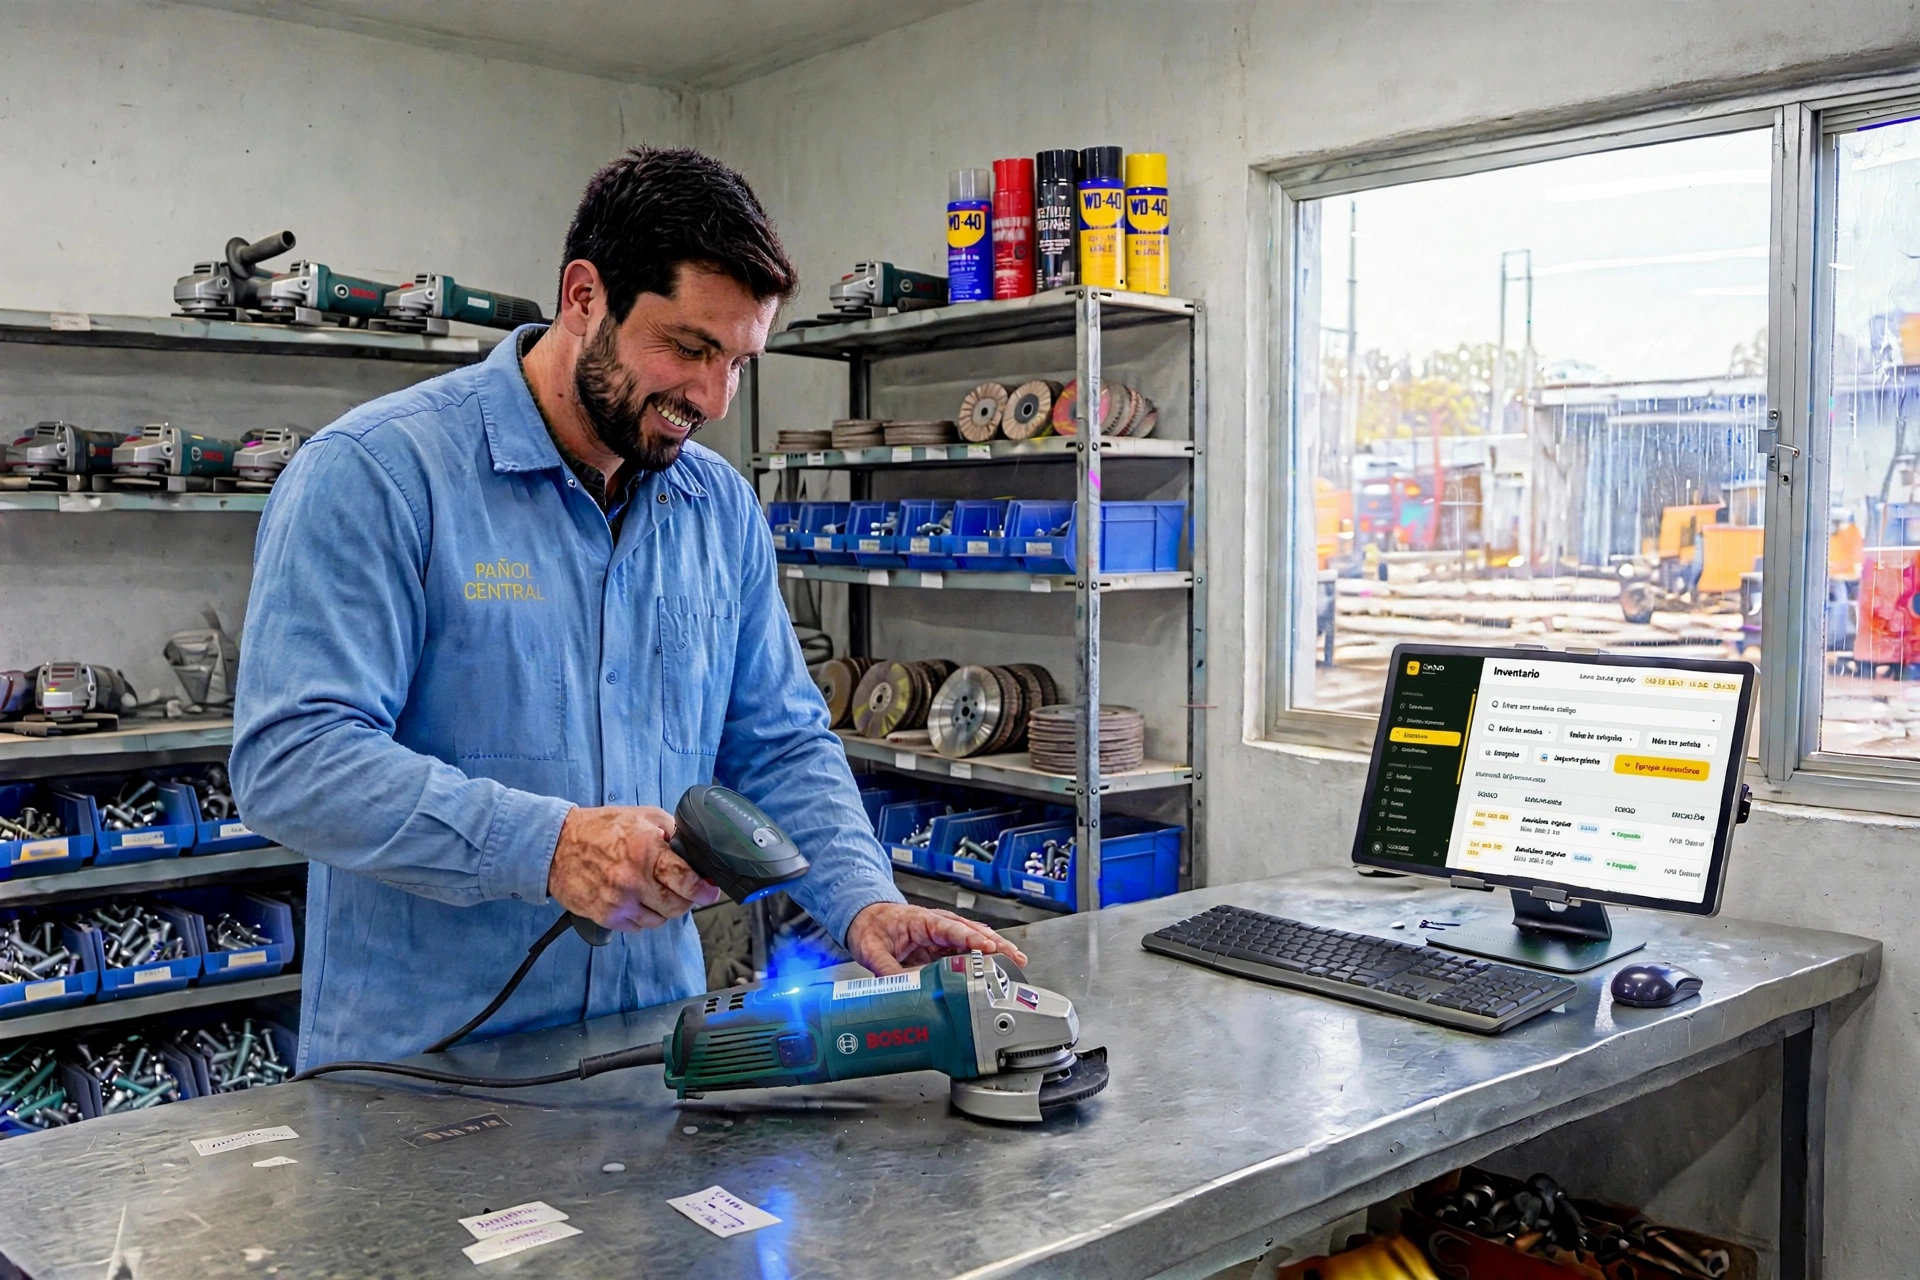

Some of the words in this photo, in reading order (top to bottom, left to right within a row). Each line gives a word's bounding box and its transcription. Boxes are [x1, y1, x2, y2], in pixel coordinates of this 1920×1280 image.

[1083, 192, 1121, 210] WD-40
[1130, 198, 1167, 216] WD-40
[475, 558, 534, 579] PAÑOL
[464, 582, 545, 600] CENTRAL
[1493, 666, 1540, 679] Inventario
[866, 1025, 929, 1049] BOSCH
